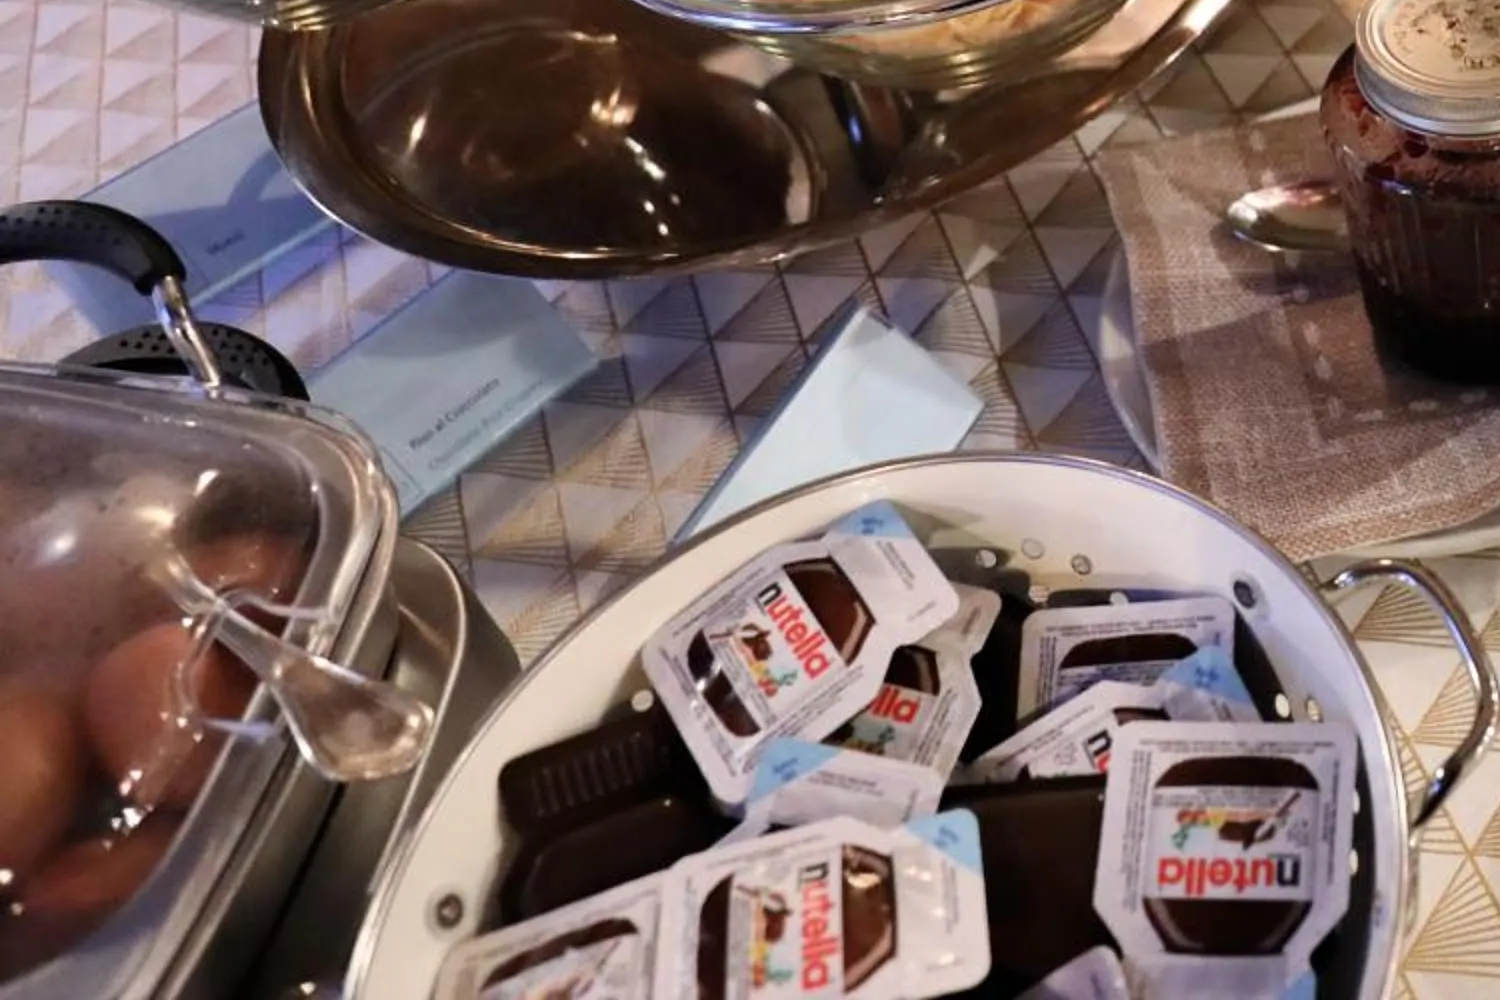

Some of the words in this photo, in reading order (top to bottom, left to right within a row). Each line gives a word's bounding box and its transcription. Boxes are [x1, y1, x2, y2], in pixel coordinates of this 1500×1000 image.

[755, 582, 831, 680] nutella
[1158, 856, 1300, 896] nutella
[800, 861, 840, 990] nutella
